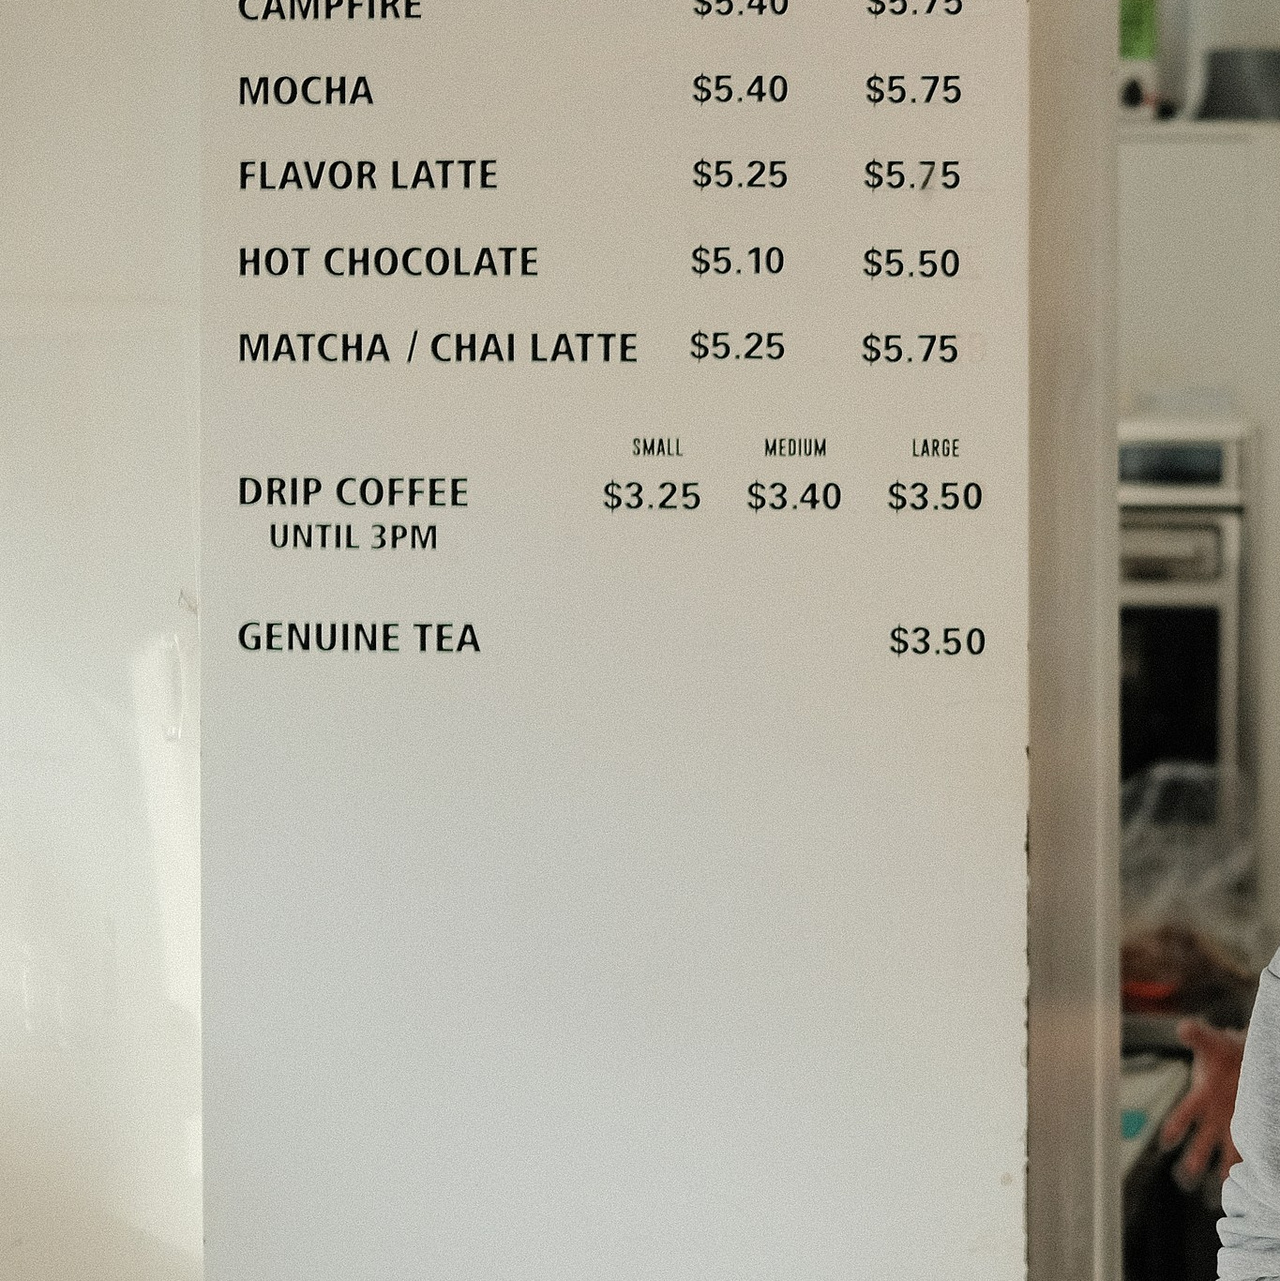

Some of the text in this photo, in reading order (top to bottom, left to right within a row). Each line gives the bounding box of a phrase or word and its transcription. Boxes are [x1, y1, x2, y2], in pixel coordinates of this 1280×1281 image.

[239, 73, 962, 105] MOCHA $5.40 $5.75
[240, 158, 960, 190] FLAVOR LATTE $5.25 $5.75
[239, 245, 960, 278] HOT CHOCOLATE $5.10 $5.50
[239, 333, 390, 362] MATCHA
[430, 333, 515, 362] CHAI
[531, 333, 637, 363] LATTE
[690, 330, 785, 360] $5.25
[862, 333, 958, 364] $5.75
[632, 437, 959, 458] SMALL MEDIUM LARGE
[239, 477, 983, 512] DRIP COFFEE $3.25 $3.40 $3.50
[270, 523, 437, 550] UNTIL 3PM
[238, 622, 986, 656] GENUINE TEA $3.50
